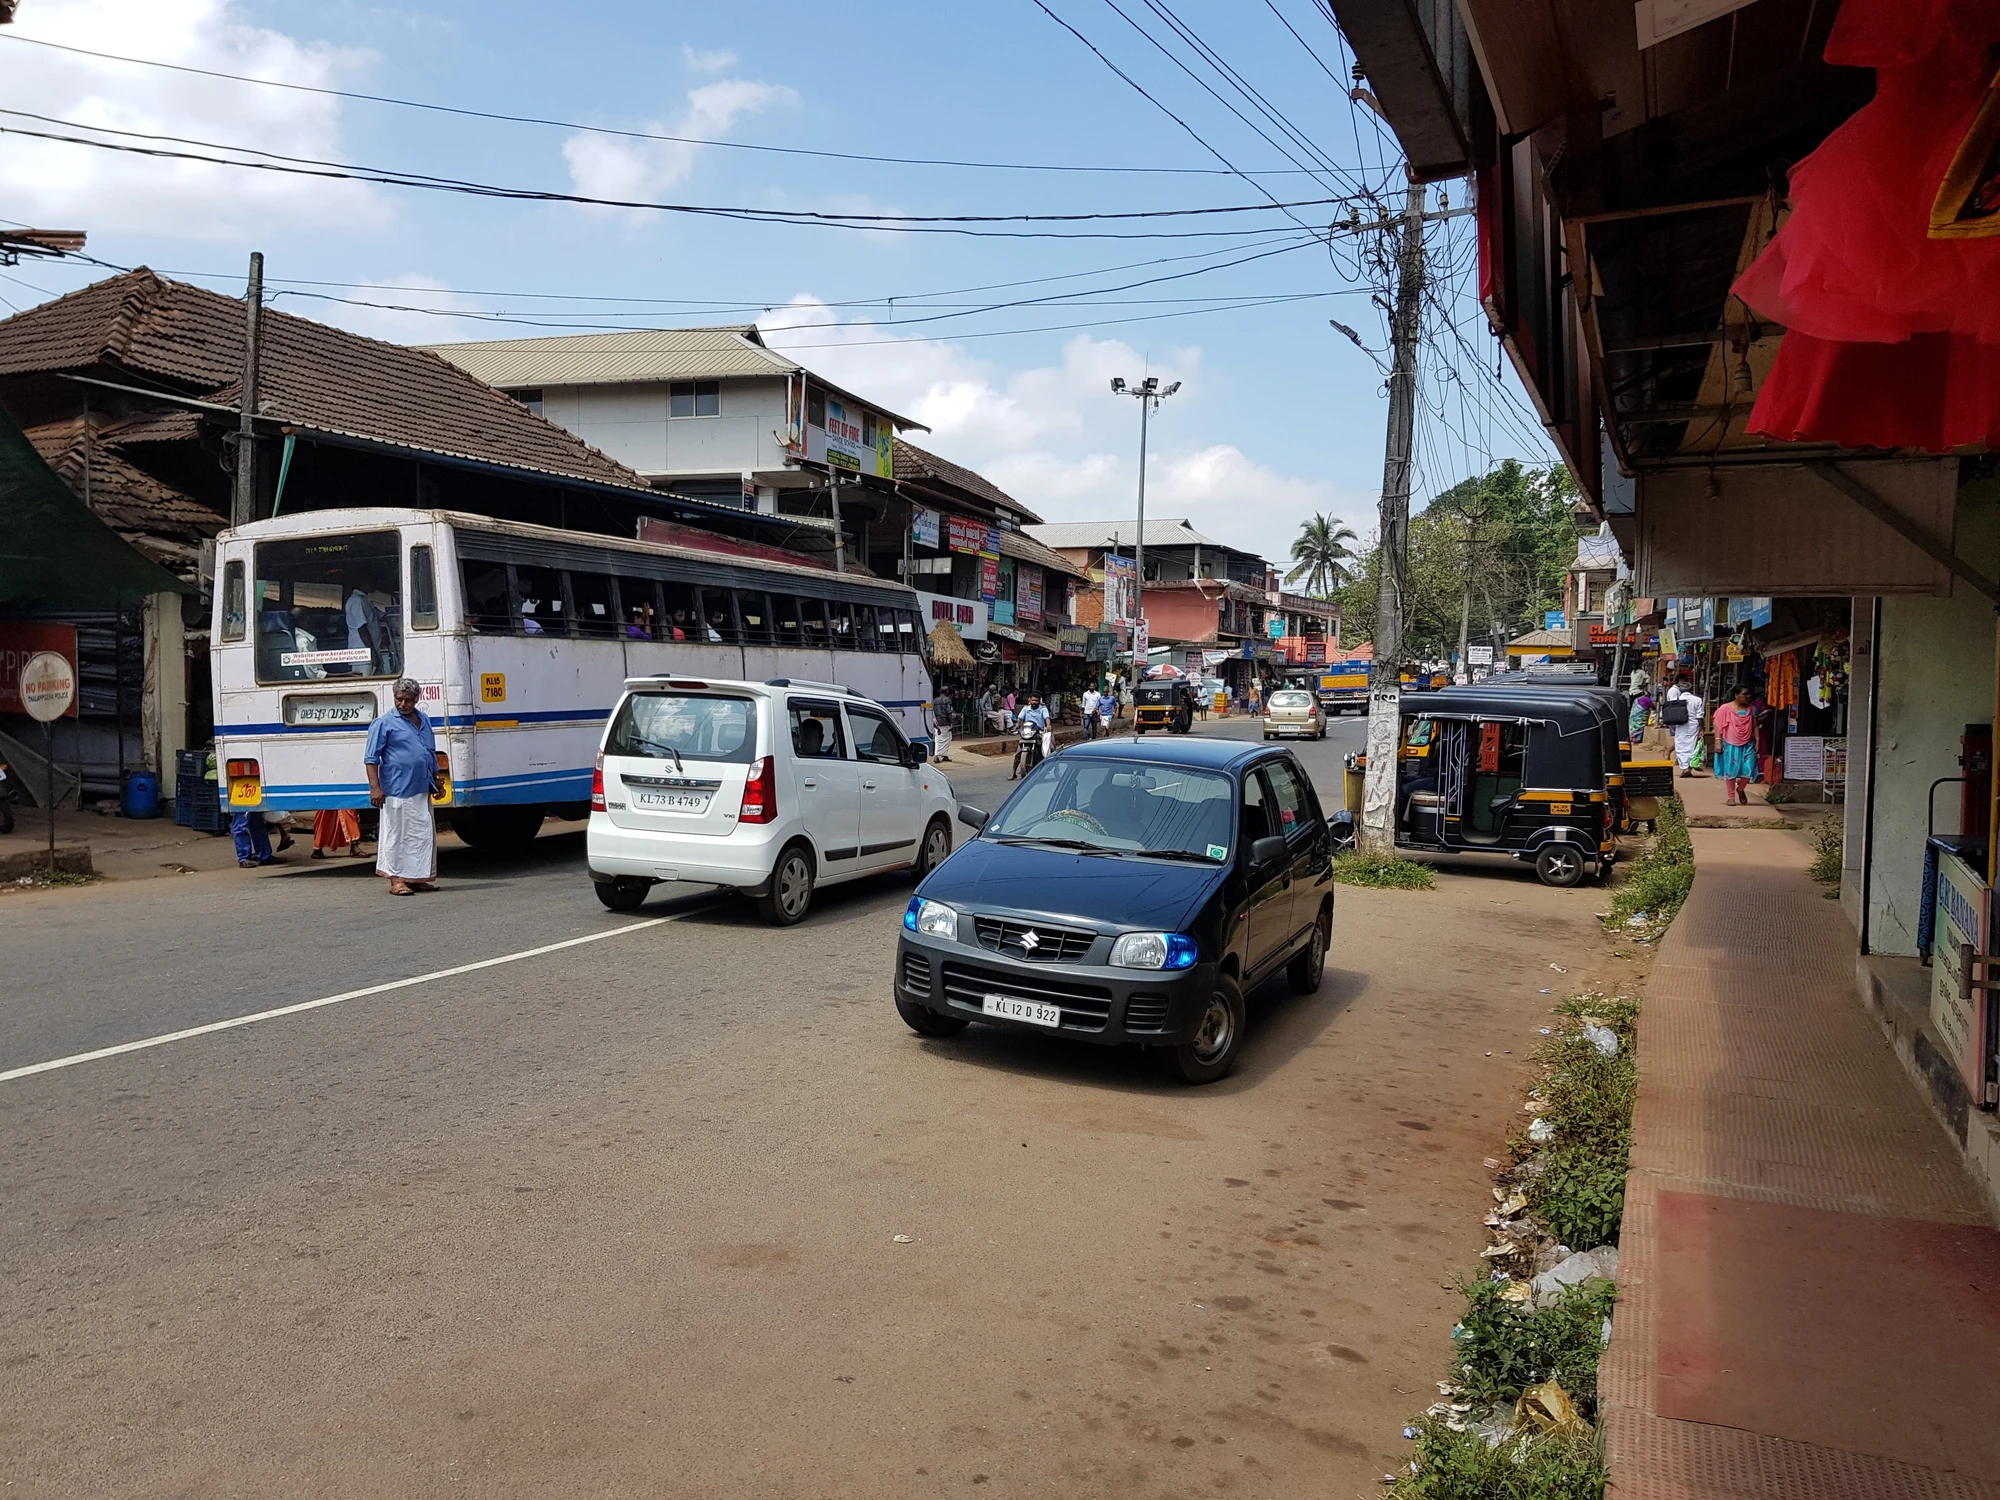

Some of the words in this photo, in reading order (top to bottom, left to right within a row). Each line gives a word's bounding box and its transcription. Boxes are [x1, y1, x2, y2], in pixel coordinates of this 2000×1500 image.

[26, 683, 36, 694] NO
[37, 678, 70, 692] PARKING
[419, 686, 440, 701] K981
[485, 687, 503, 697] 7180
[996, 1001, 1008, 1013] KL
[1012, 1004, 1022, 1015] 12
[1026, 1006, 1032, 1017] D
[1036, 1008, 1056, 1022] 922
